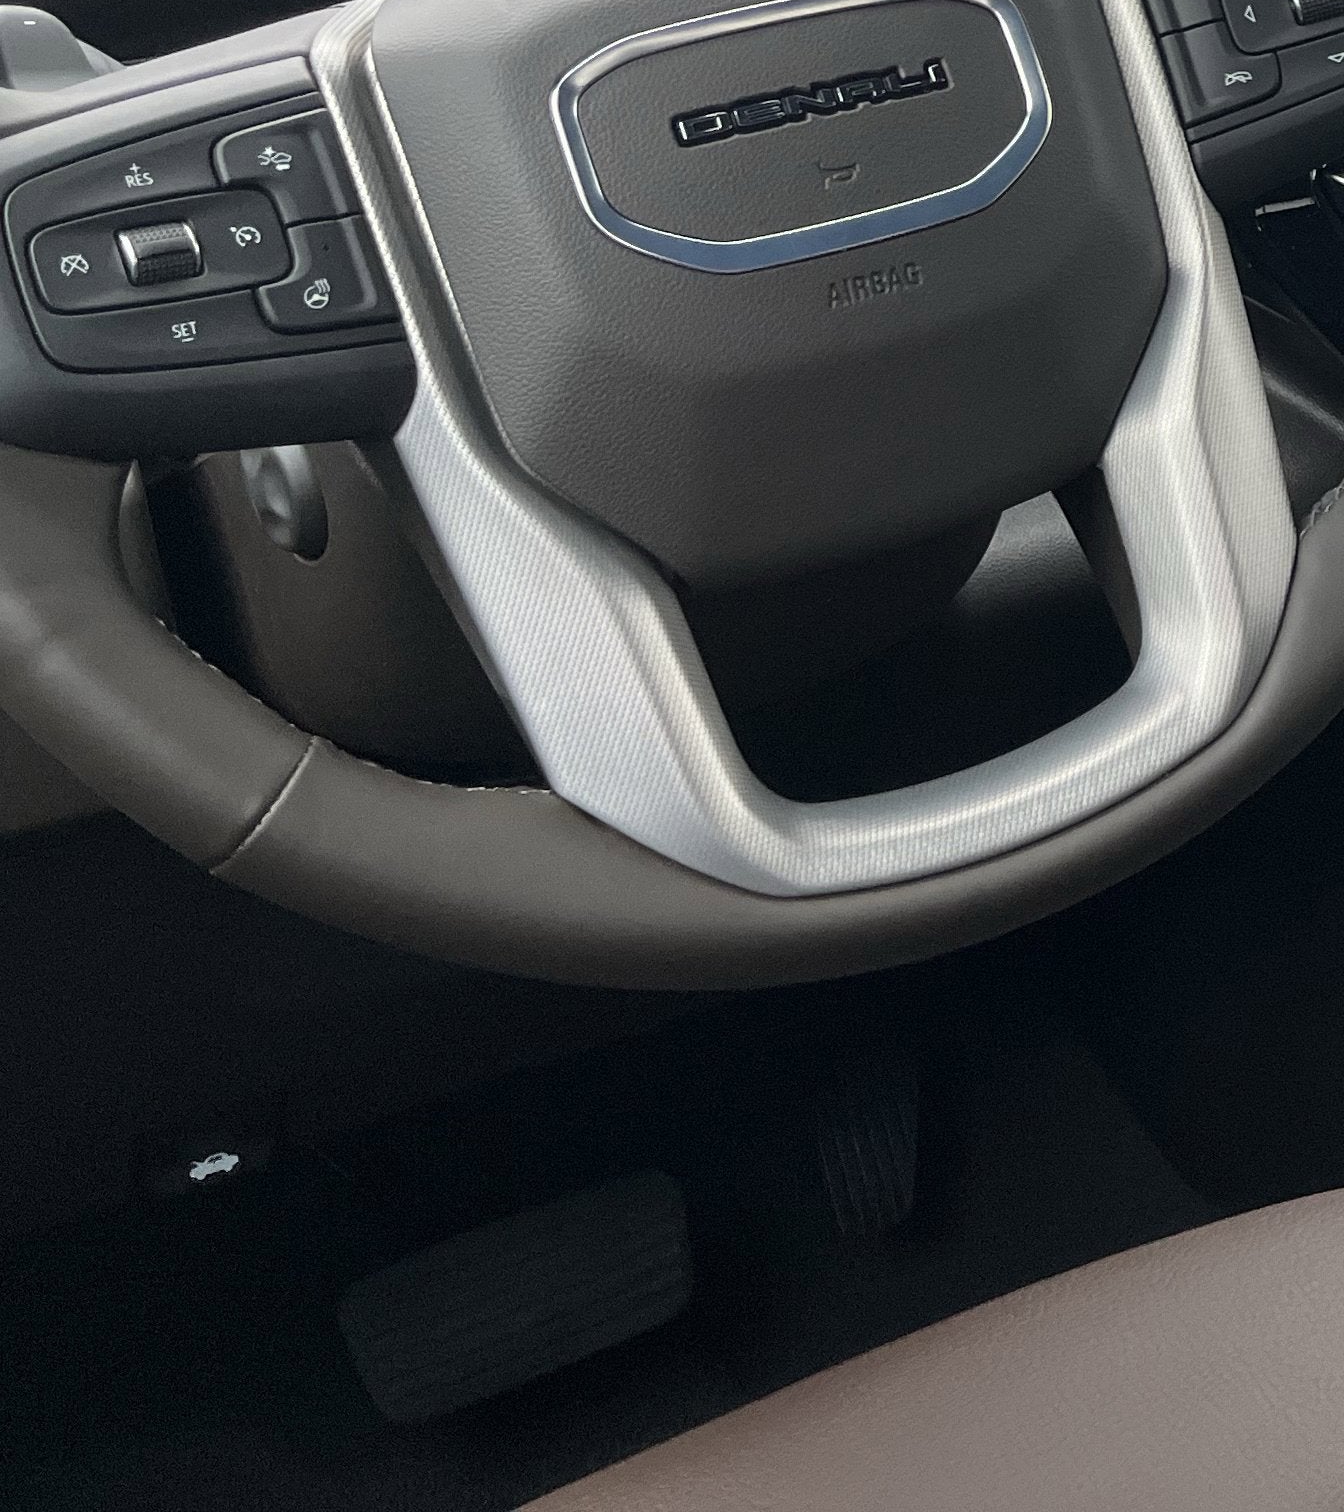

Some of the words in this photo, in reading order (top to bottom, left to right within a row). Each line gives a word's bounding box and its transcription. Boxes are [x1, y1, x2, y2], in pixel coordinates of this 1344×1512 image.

[672, 59, 951, 146] DENALI
[125, 172, 153, 188] RES
[828, 263, 924, 309] AIRBAG
[172, 321, 197, 338] SET
